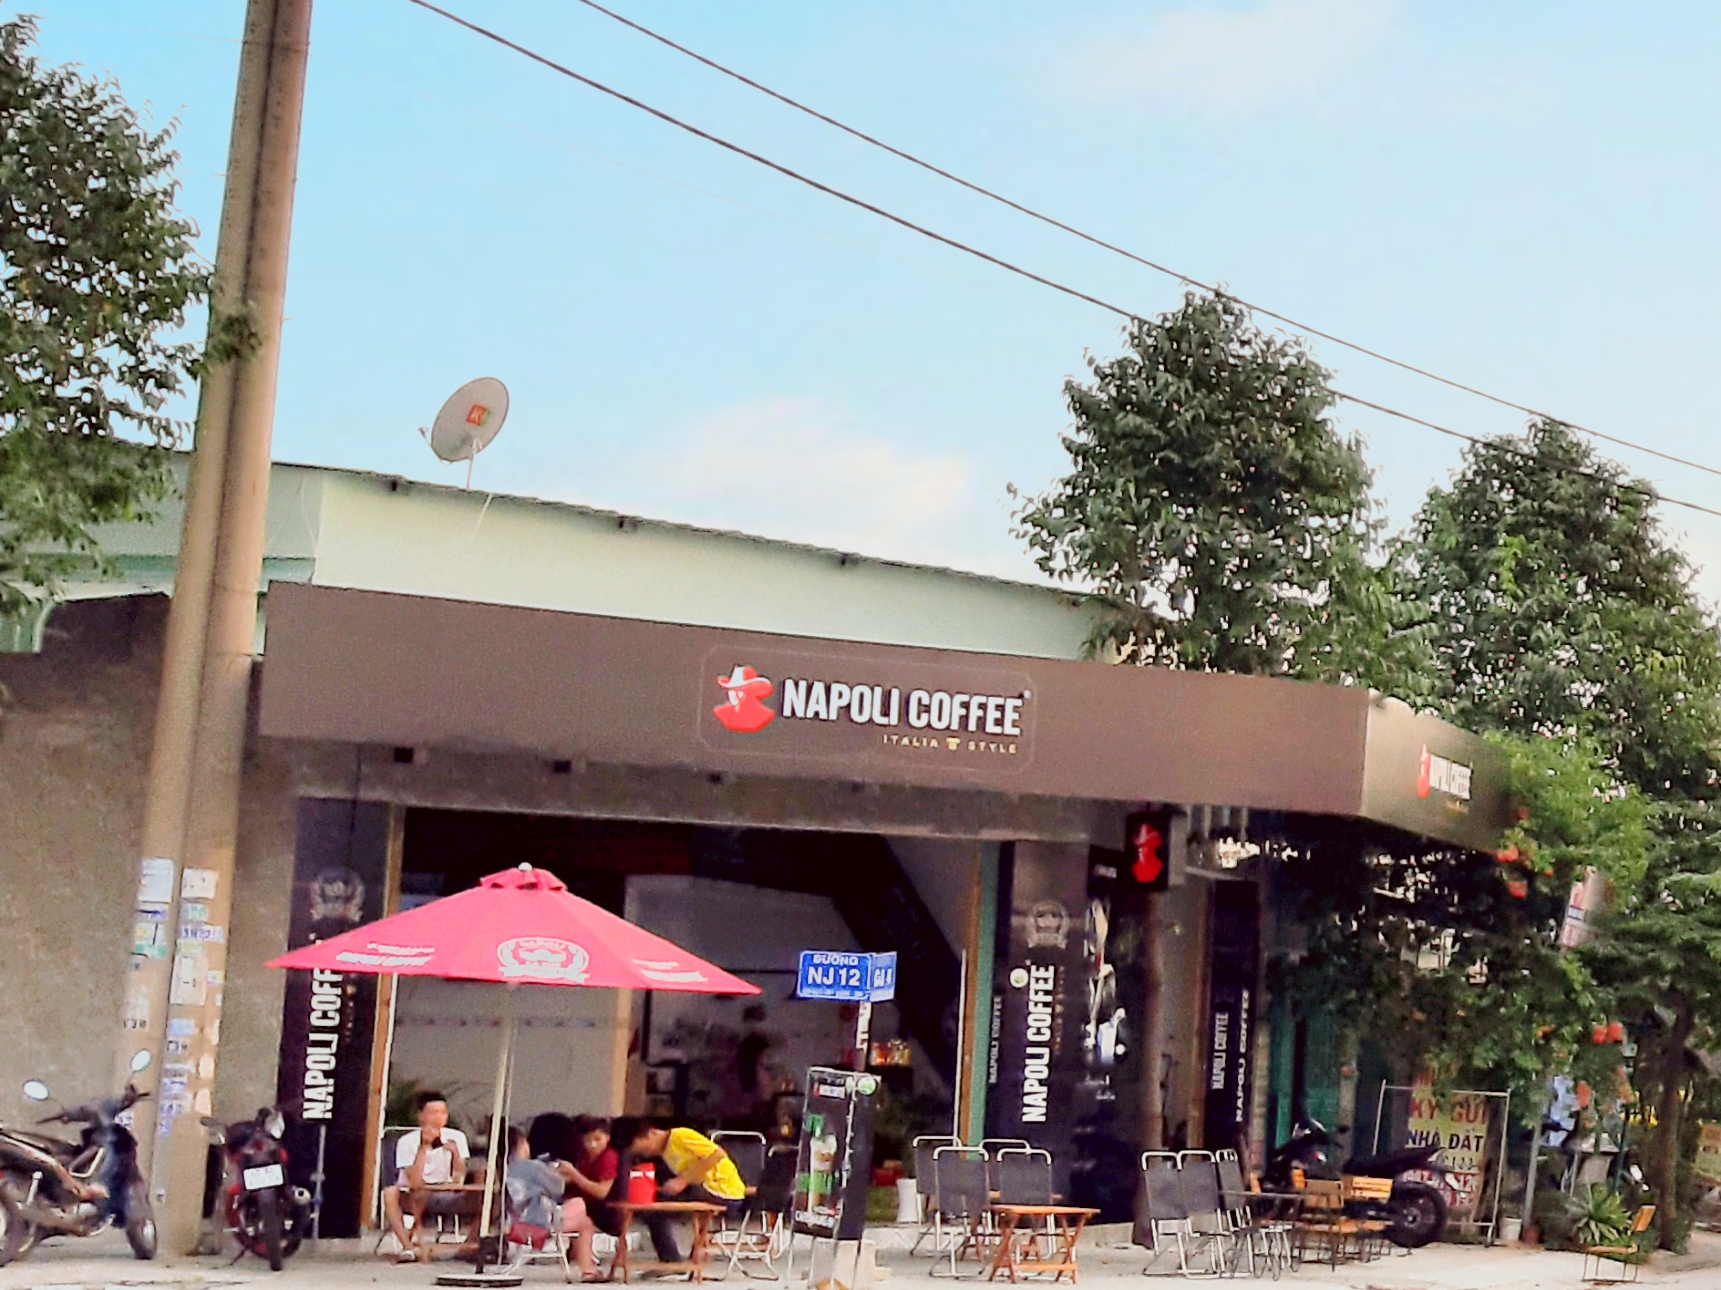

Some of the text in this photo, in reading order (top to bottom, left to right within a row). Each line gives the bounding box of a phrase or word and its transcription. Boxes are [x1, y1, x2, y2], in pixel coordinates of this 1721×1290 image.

[782, 678, 1023, 736] NAPOLI COFFEE
[883, 734, 1017, 754] ITALIA STYLE
[807, 966, 860, 987] NJ 12
[303, 968, 344, 1119] NAPOLI COFF
[1022, 964, 1055, 1122] NAPOLI COFFEE
